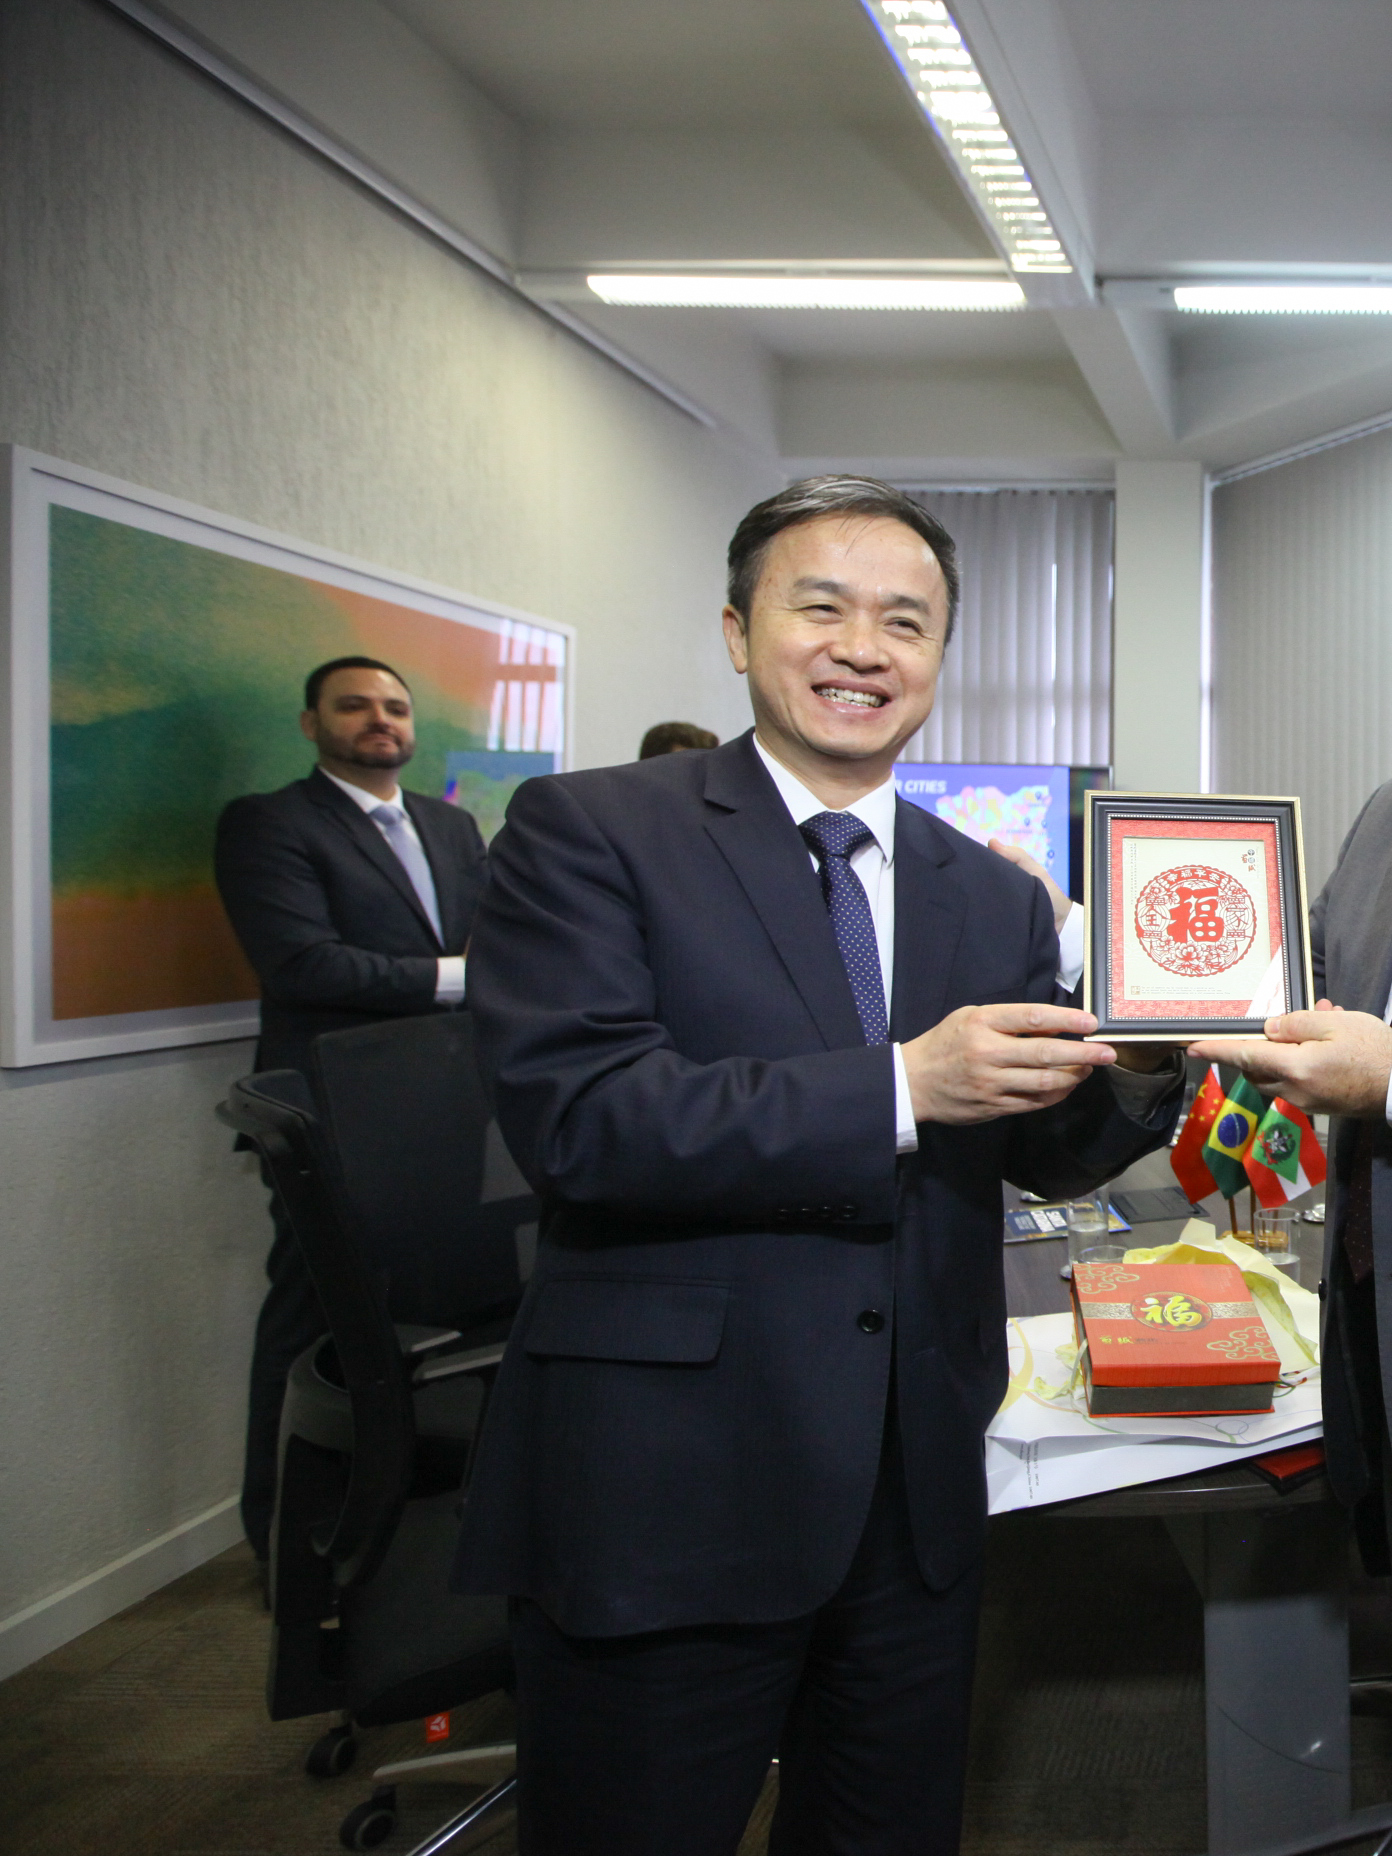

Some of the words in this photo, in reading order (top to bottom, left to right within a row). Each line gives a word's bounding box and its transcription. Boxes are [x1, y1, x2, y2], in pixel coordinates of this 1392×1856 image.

[904, 779, 947, 794] CITIES
[1167, 887, 1224, 943] 福
[1140, 1295, 1202, 1327] 福
